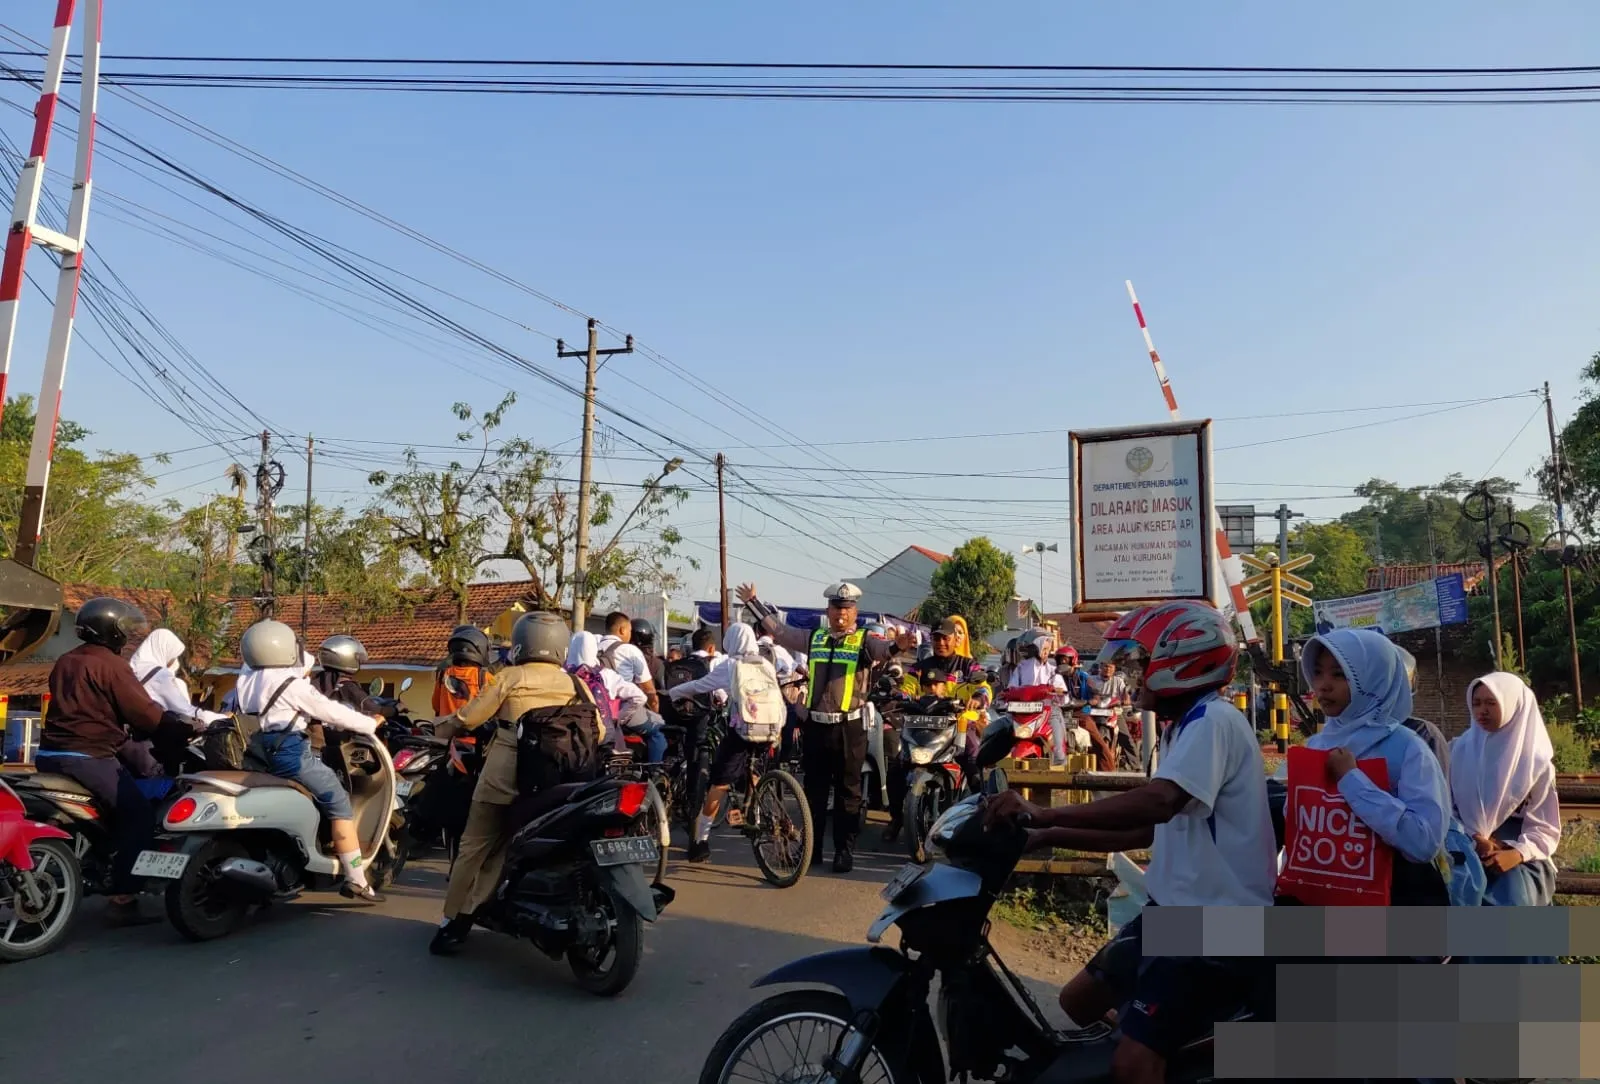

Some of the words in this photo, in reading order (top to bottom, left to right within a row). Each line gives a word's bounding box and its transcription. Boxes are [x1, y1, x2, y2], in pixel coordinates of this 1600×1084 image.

[1093, 481, 1137, 493] DEPARTEMEN
[1138, 478, 1189, 490] PERHUBUNGAN
[1091, 498, 1148, 517] DILARANG
[1152, 495, 1193, 513] MASUK
[1091, 523, 1114, 536] AREA
[1144, 519, 1177, 532] KERETA
[1180, 518, 1194, 530] API
[1094, 543, 1129, 552] ANCAMAN
[1113, 554, 1131, 563] ATAU
[1132, 552, 1172, 562] KURUNGAN
[1299, 804, 1367, 839] NICE
[1296, 835, 1336, 865] SO
